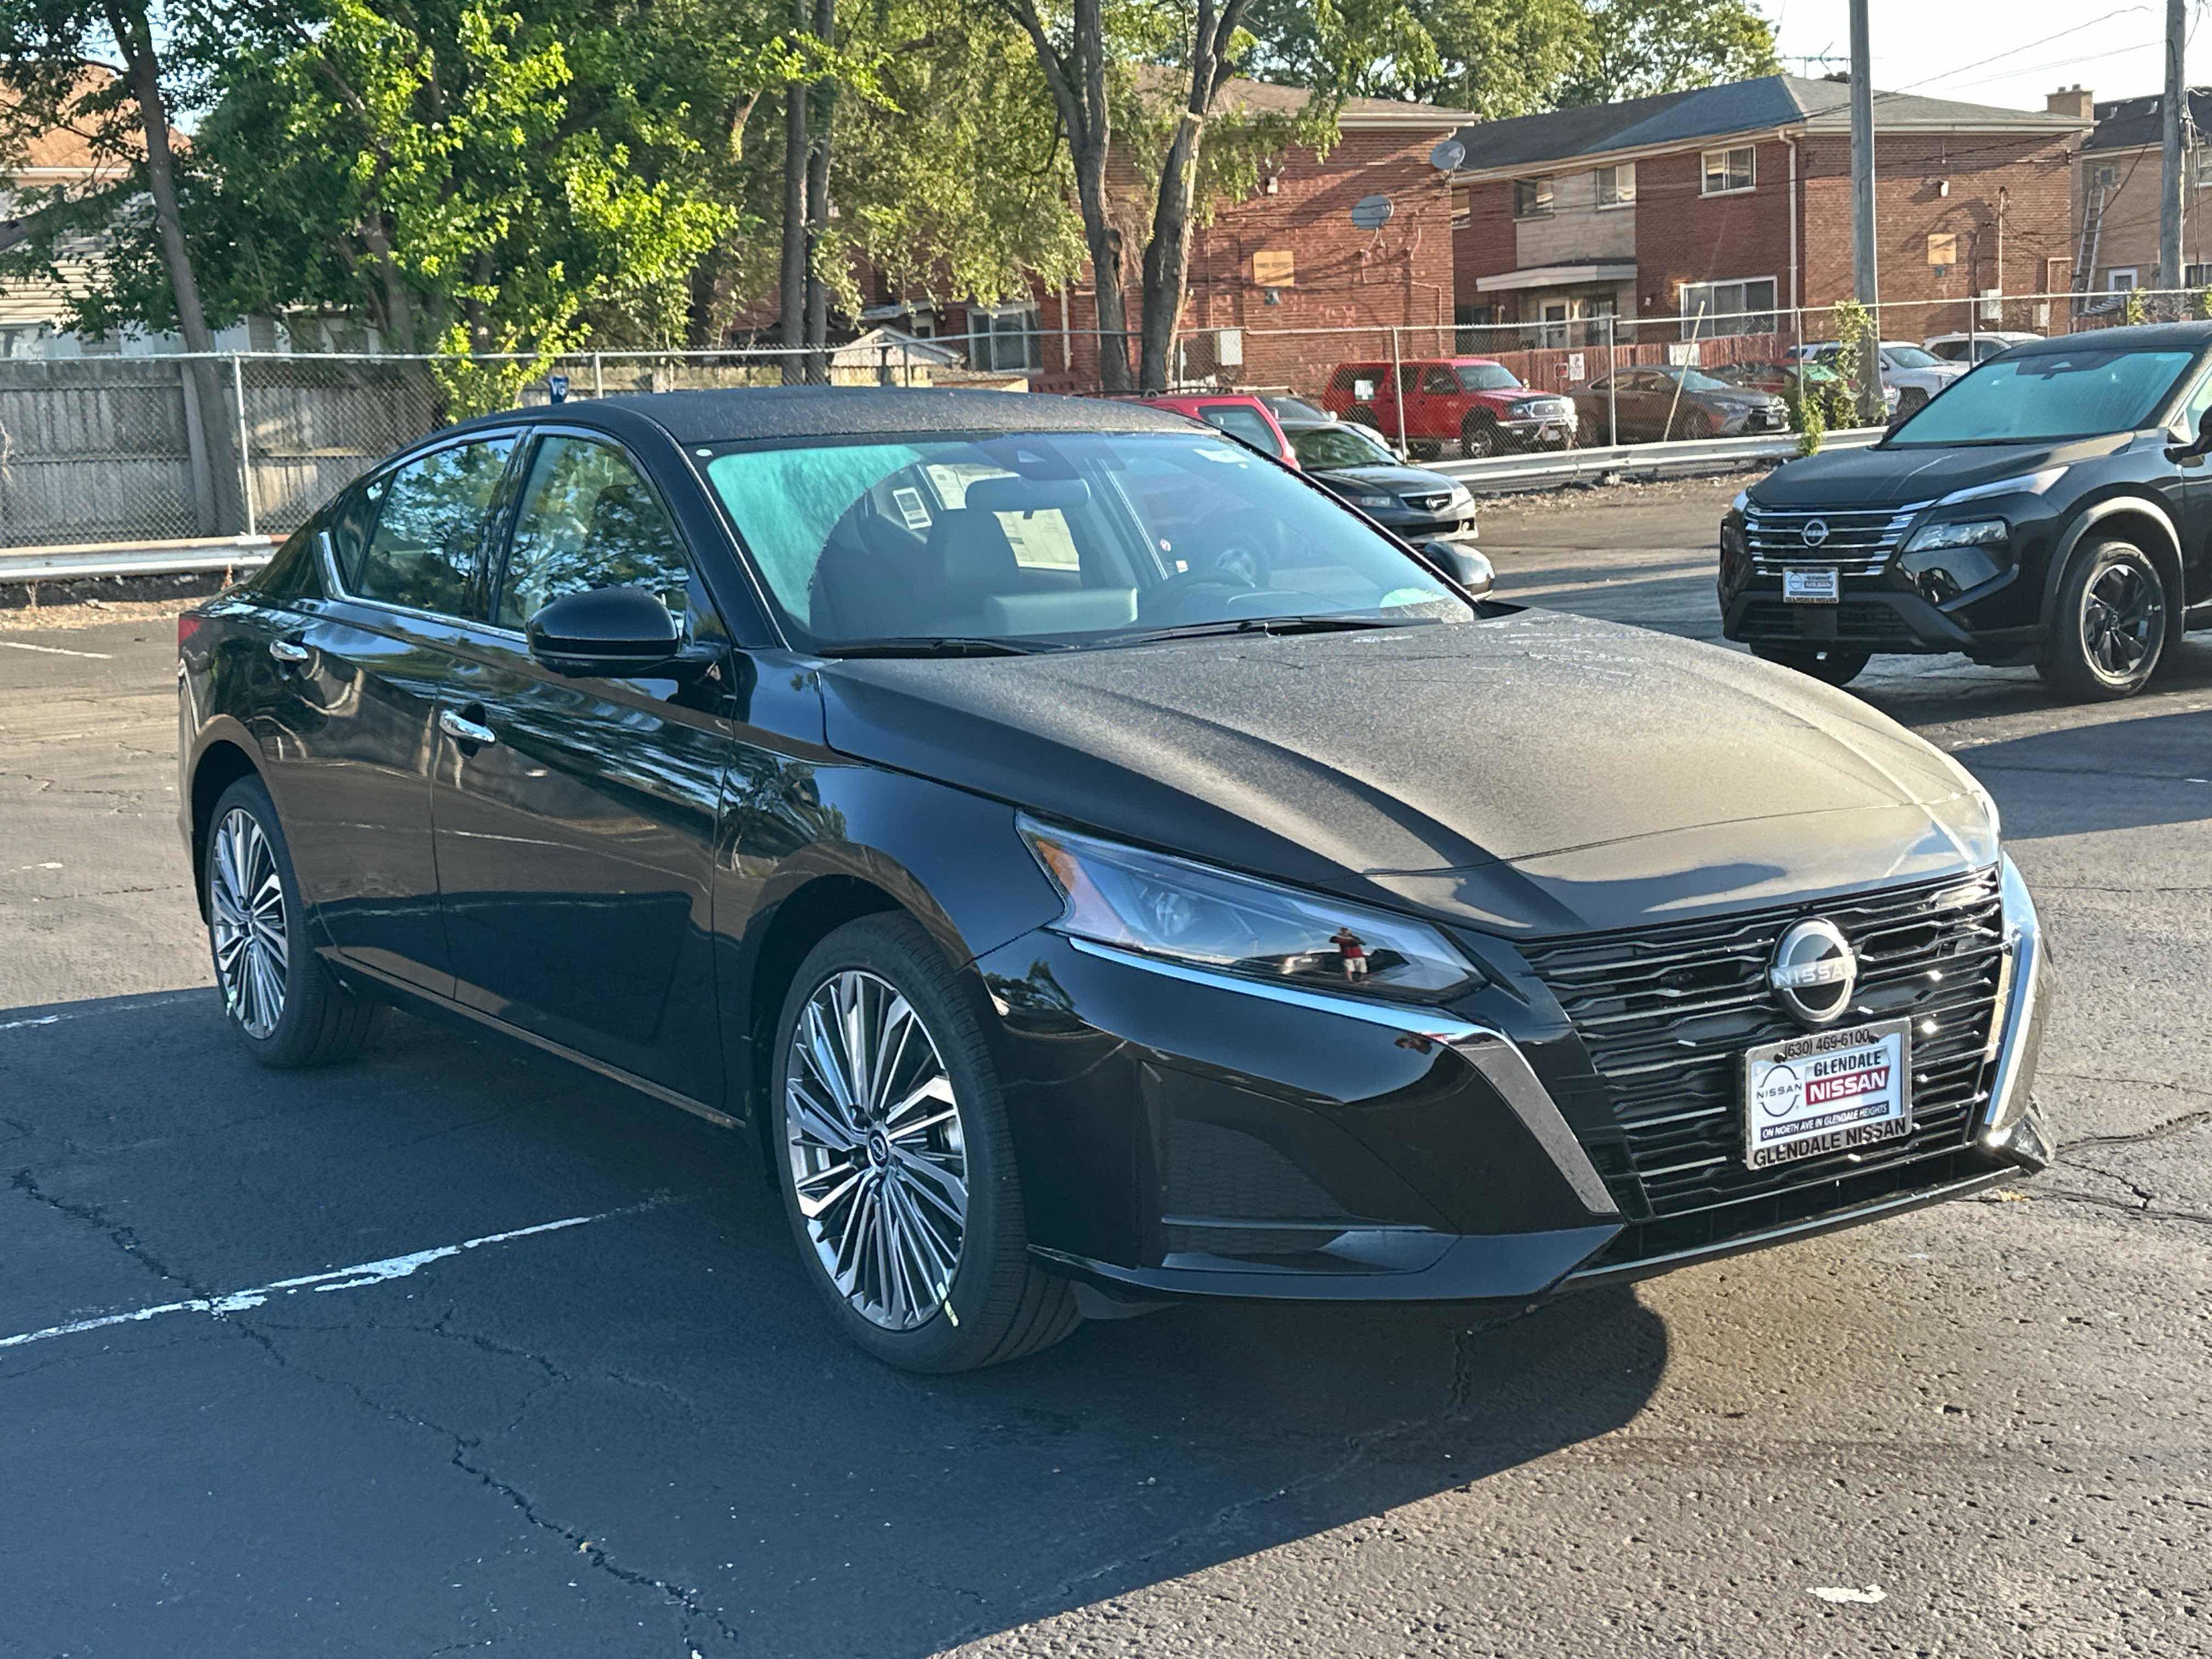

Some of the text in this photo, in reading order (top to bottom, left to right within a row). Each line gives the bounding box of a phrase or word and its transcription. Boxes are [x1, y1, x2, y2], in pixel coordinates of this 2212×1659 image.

[1784, 1029, 1870, 1057] (630) 469-6100
[1814, 1050, 1882, 1077] GLENDALE
[1756, 1082, 1802, 1099] NISSAN
[1810, 1070, 1885, 1102] NISSAN
[1762, 1128, 1774, 1139] ON
[1775, 1122, 1799, 1136] NORTH
[1800, 1119, 1814, 1132] AVE
[1815, 1118, 1823, 1128] IN
[1824, 1109, 1858, 1125] GLENDALE
[1753, 1118, 1906, 1166] GLENDALE NISSAN
